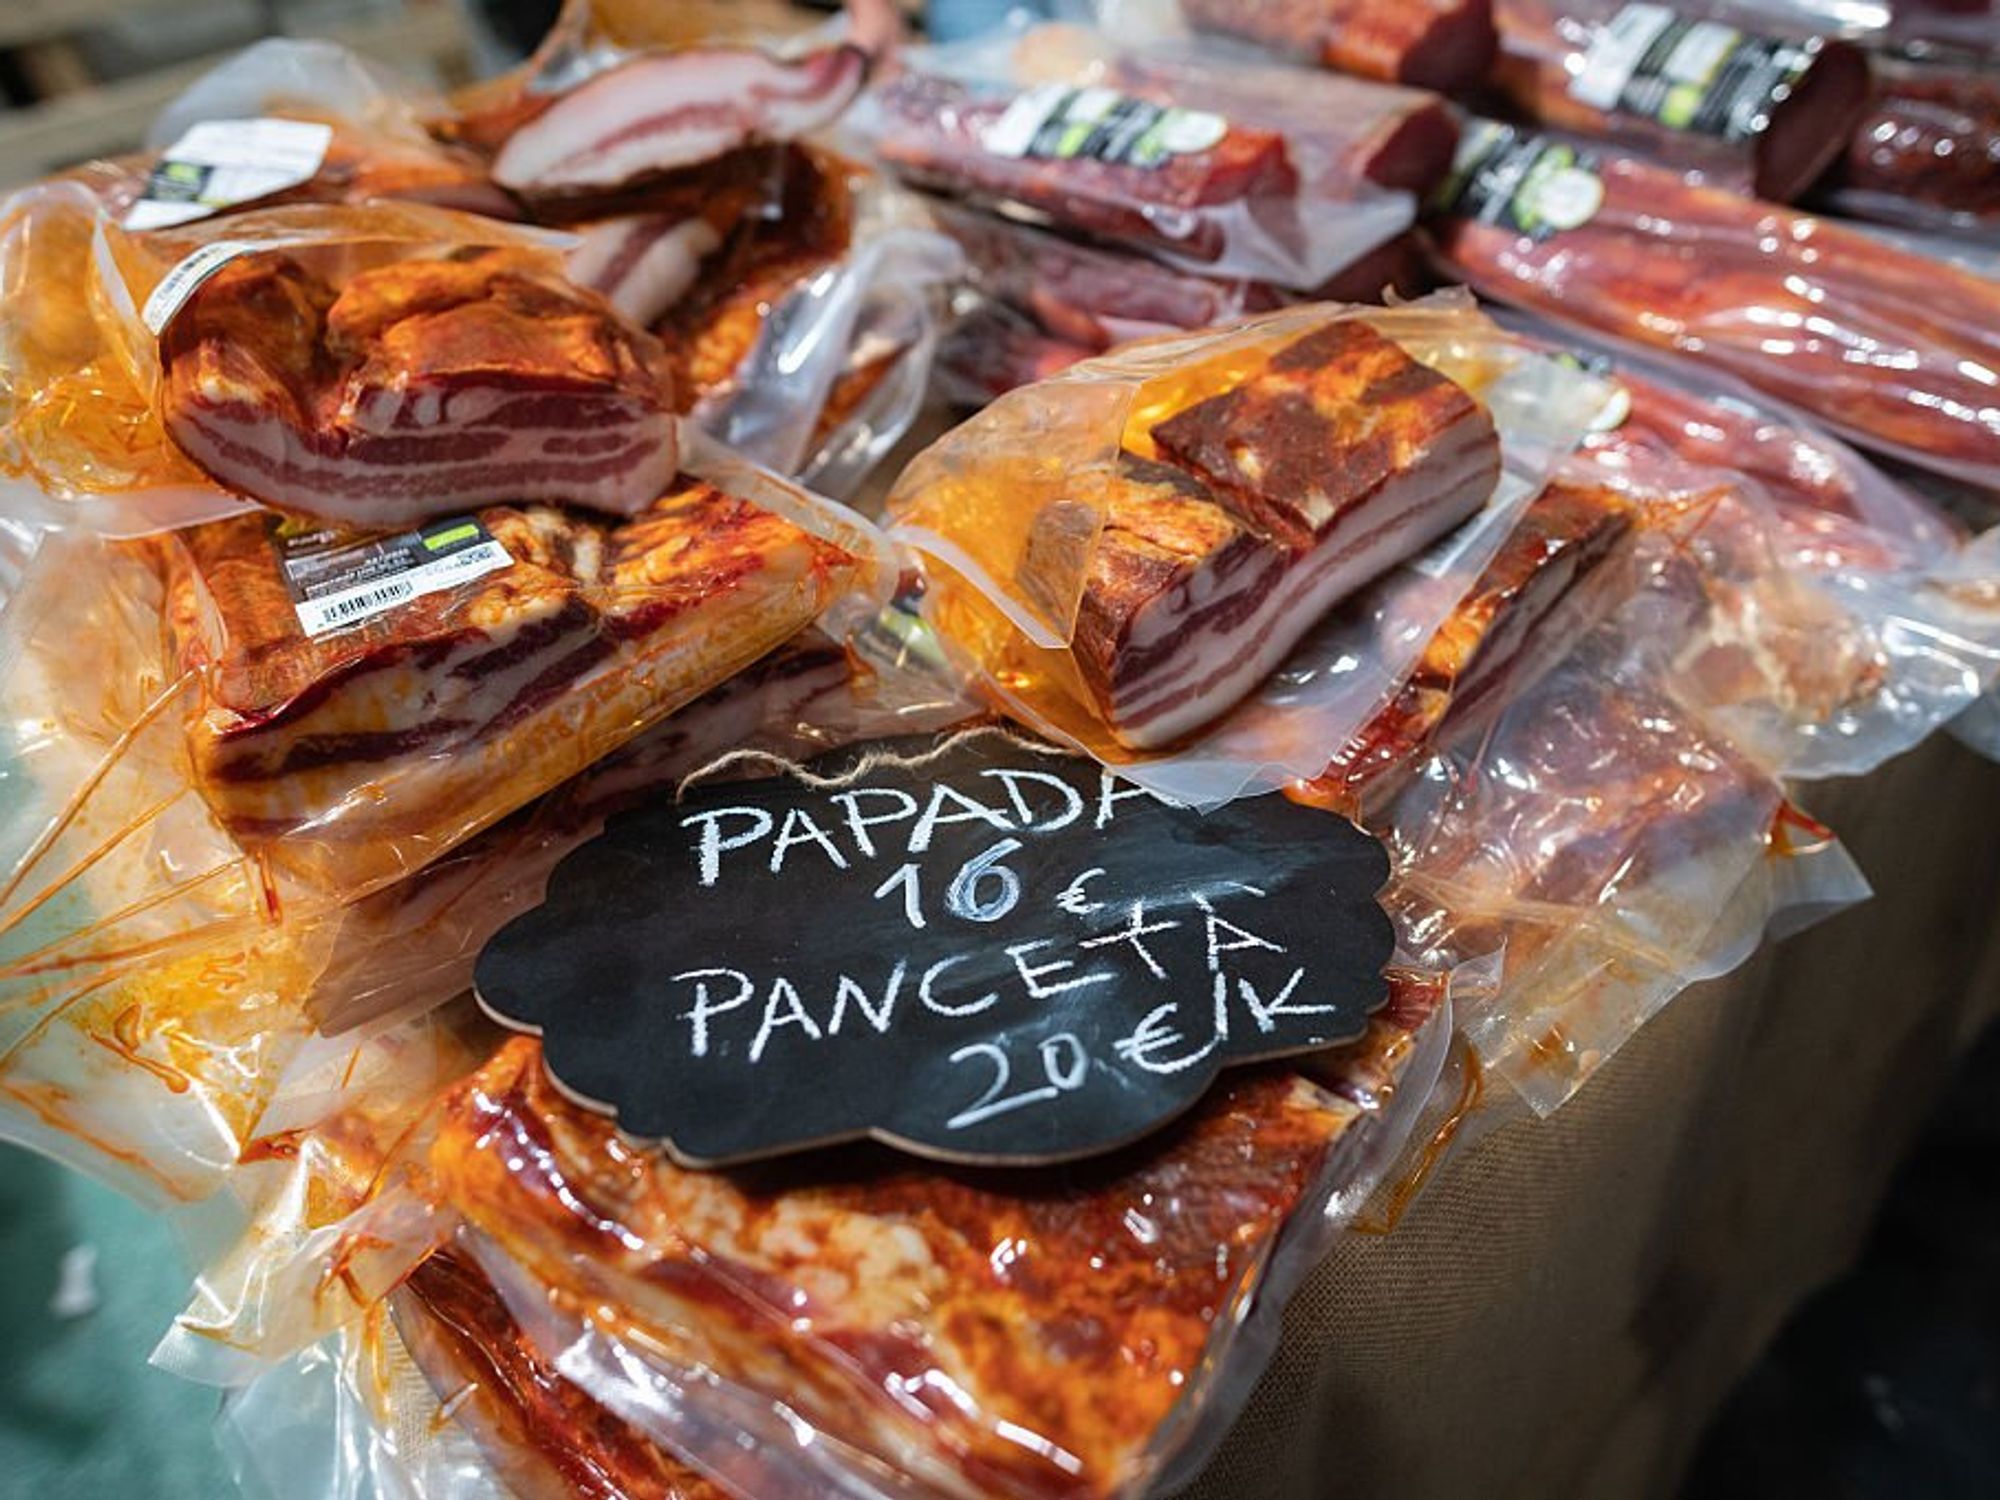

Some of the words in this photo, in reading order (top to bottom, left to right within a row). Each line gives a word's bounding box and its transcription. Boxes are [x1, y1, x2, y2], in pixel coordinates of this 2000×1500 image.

[873, 838, 1023, 929] 16
[1056, 868, 1106, 915] €
[670, 880, 1288, 1063] PANCETA
[946, 1033, 1090, 1130] 20
